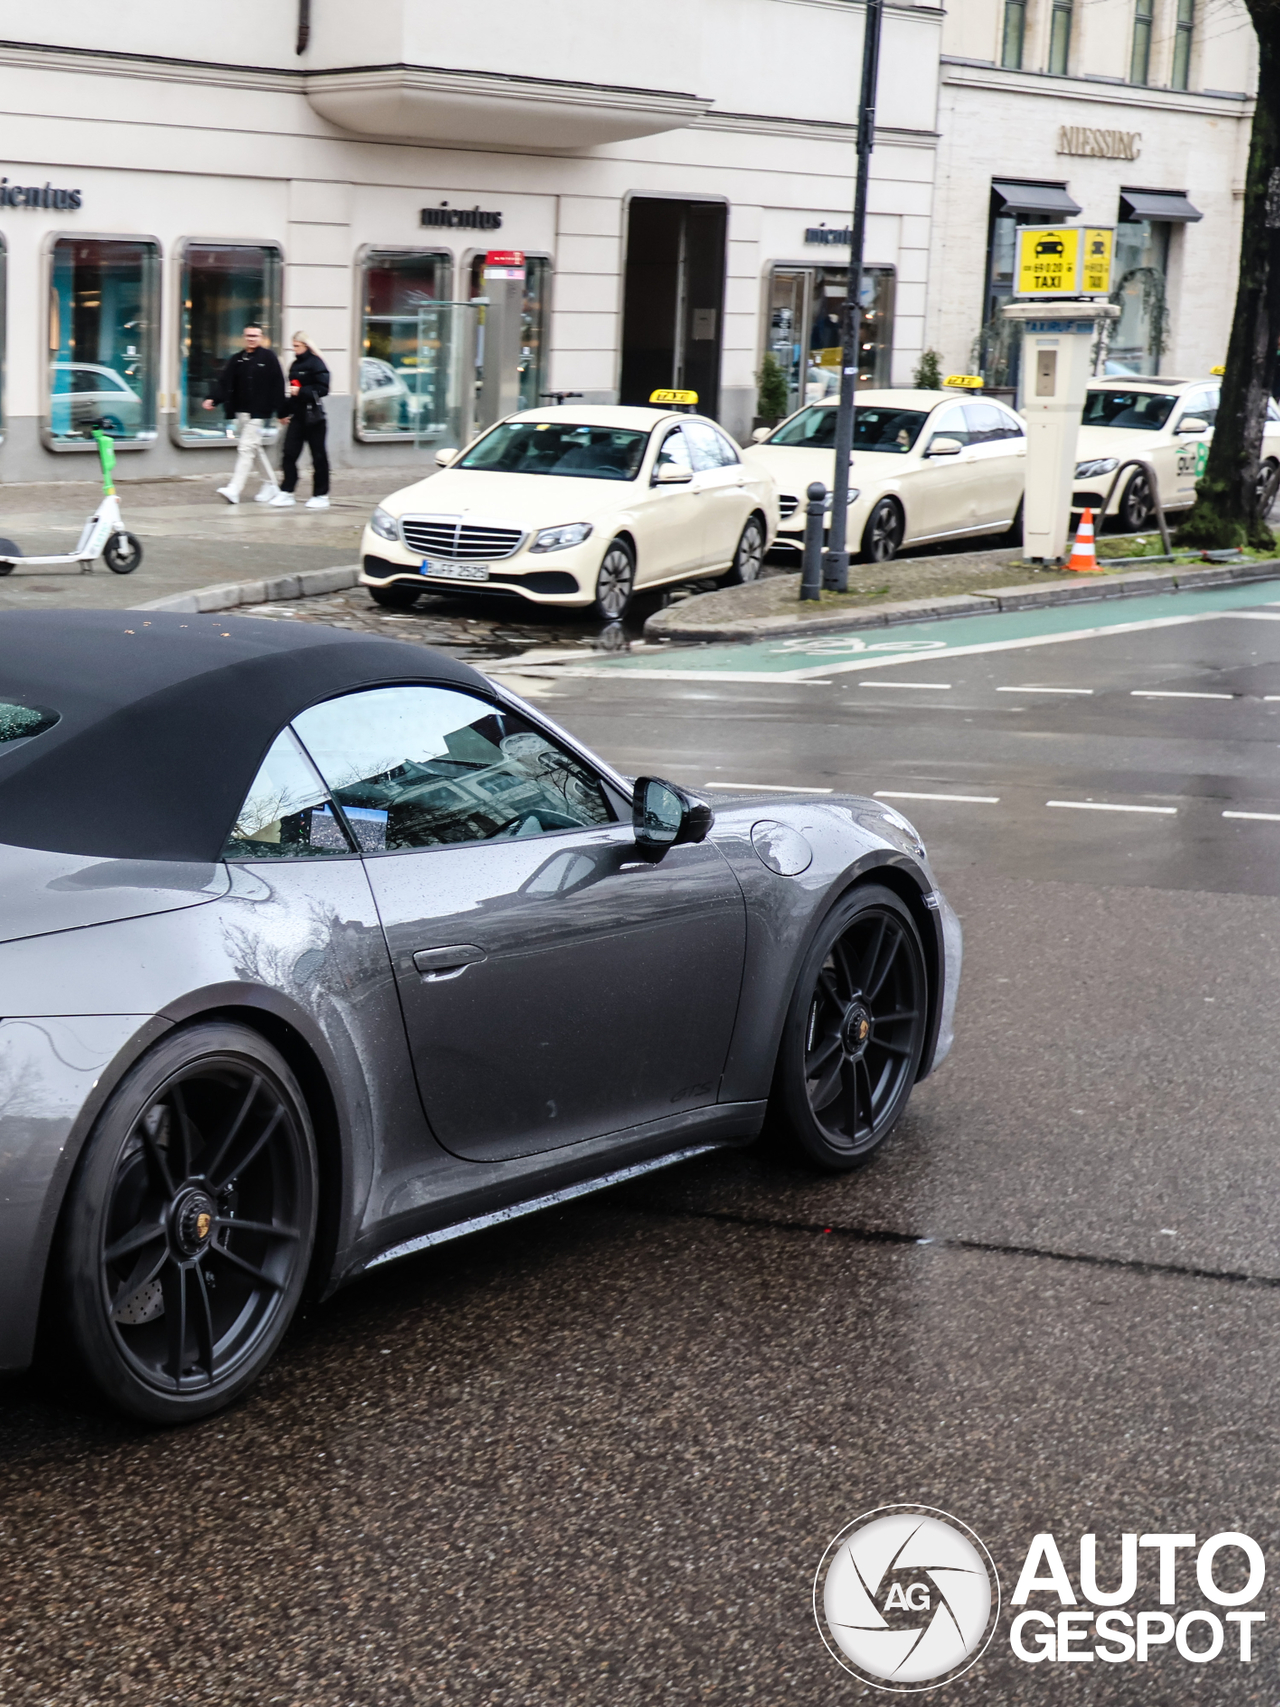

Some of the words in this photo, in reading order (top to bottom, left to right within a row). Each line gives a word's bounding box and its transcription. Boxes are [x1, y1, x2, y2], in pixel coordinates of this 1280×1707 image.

[1057, 125, 1141, 160] NIESSING
[420, 201, 502, 229] mientus
[1034, 276, 1062, 289] TAXI
[948, 375, 976, 386] TAXI
[656, 391, 689, 402] TAXI
